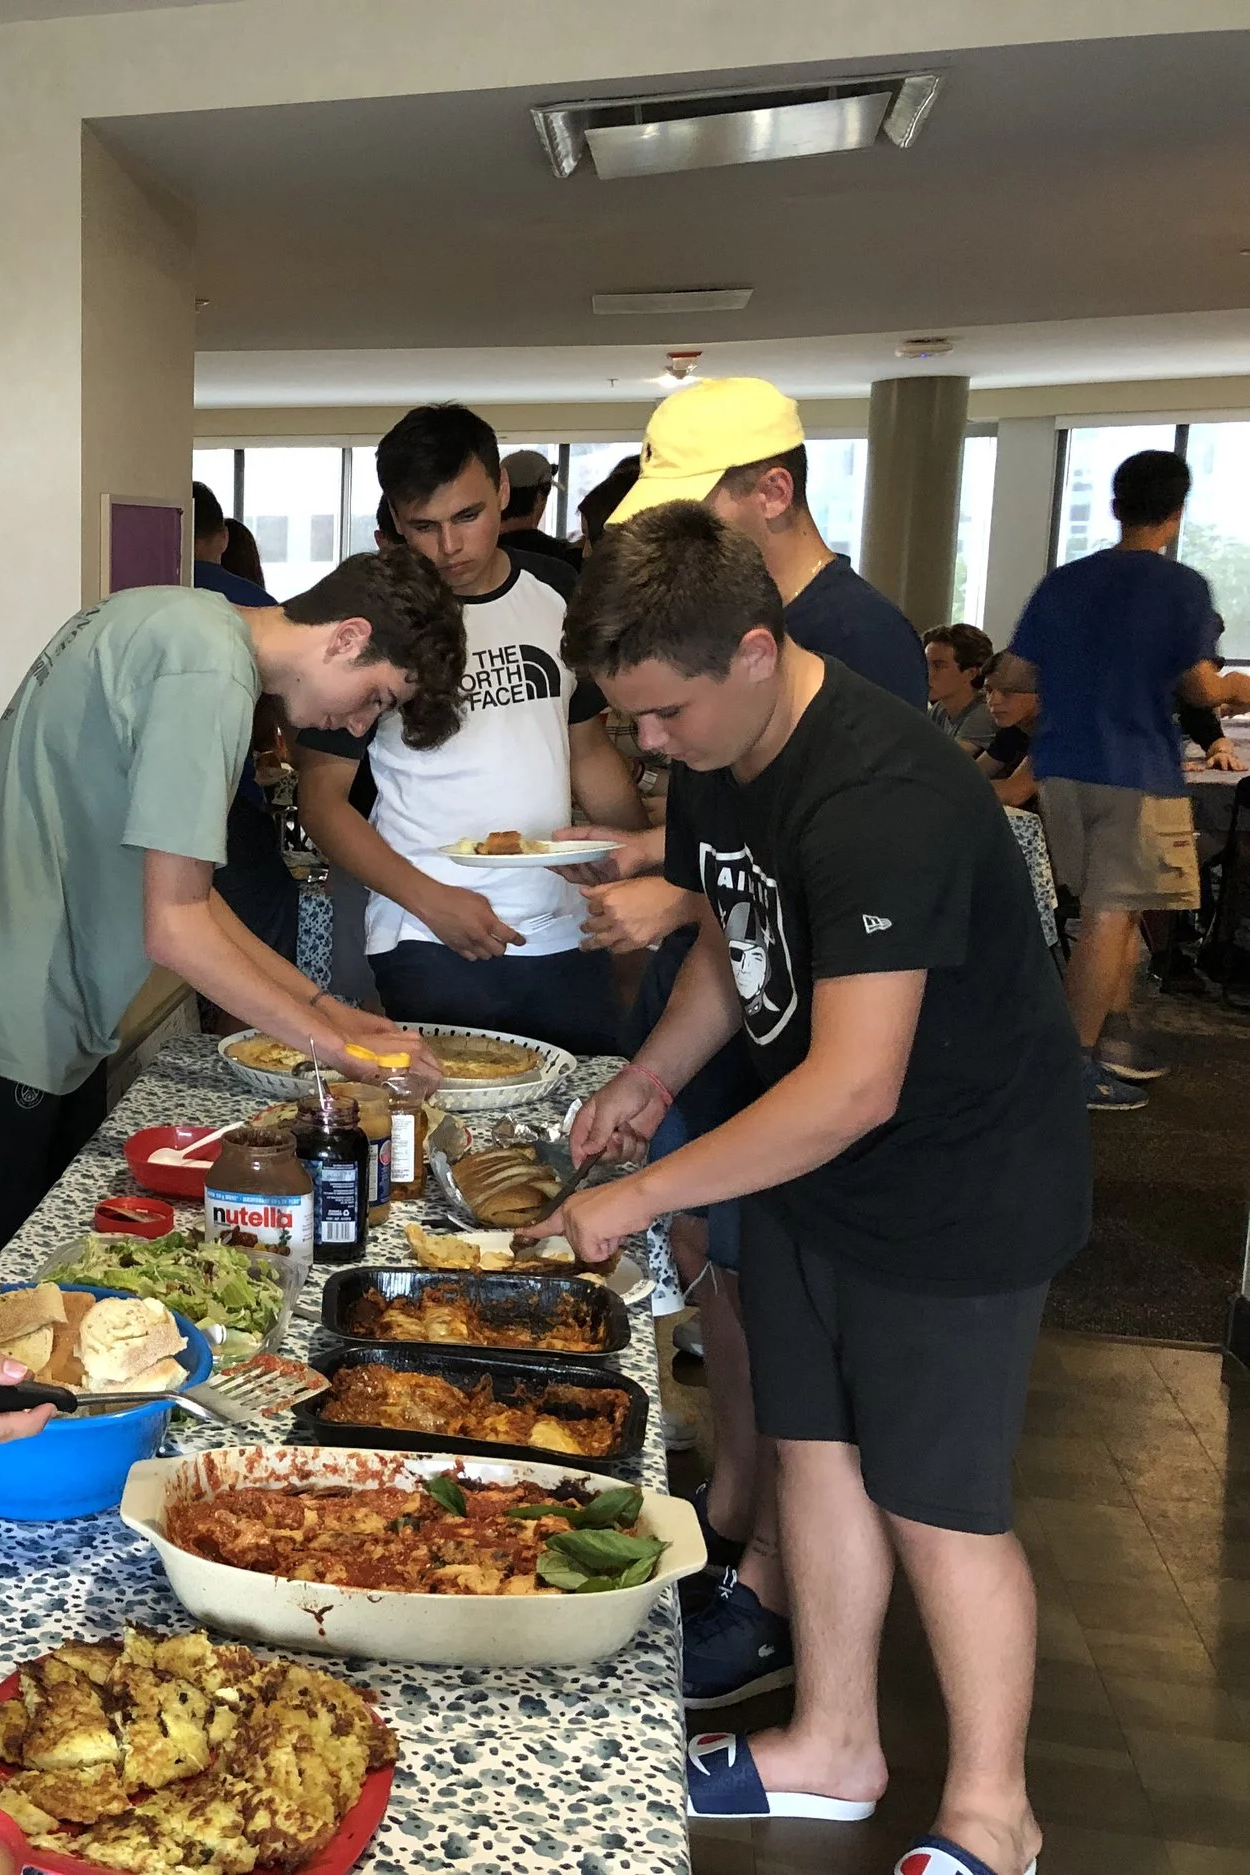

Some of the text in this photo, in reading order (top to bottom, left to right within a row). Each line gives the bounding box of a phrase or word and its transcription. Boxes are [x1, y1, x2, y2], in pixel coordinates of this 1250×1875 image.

[471, 644, 520, 670] THE
[459, 663, 523, 692] ORTH
[468, 683, 525, 712] FACE
[213, 1206, 293, 1229] nutella
